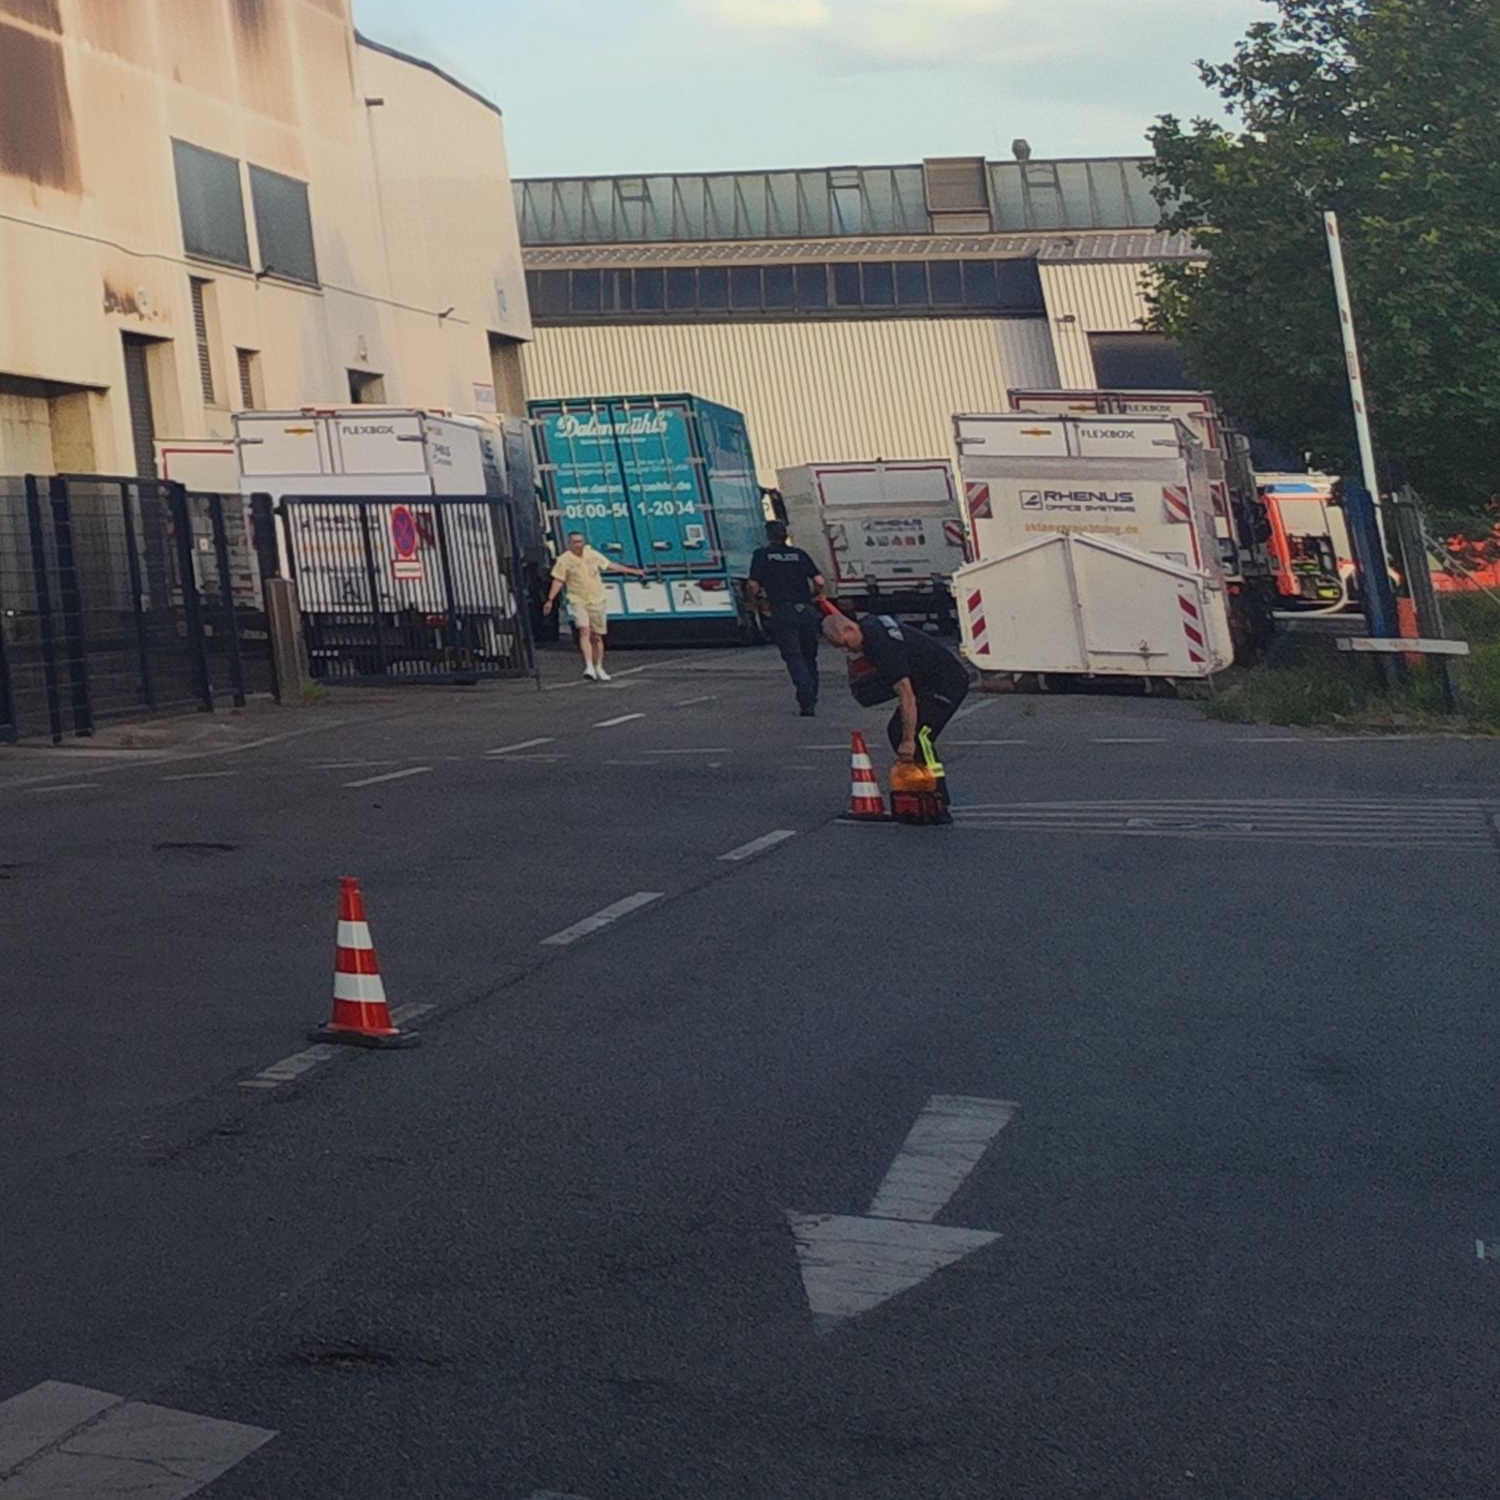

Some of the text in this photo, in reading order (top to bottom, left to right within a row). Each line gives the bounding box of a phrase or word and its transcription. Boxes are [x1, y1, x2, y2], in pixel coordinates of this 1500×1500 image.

[1127, 404, 1172, 413] LEXBOX
[342, 425, 395, 435] FLEXBOX
[1081, 429, 1135, 439] FLEXBOX
[1044, 490, 1135, 503] RHENUS
[1045, 504, 1136, 513] OFFICE SYSTEMS
[682, 589, 695, 606] A
